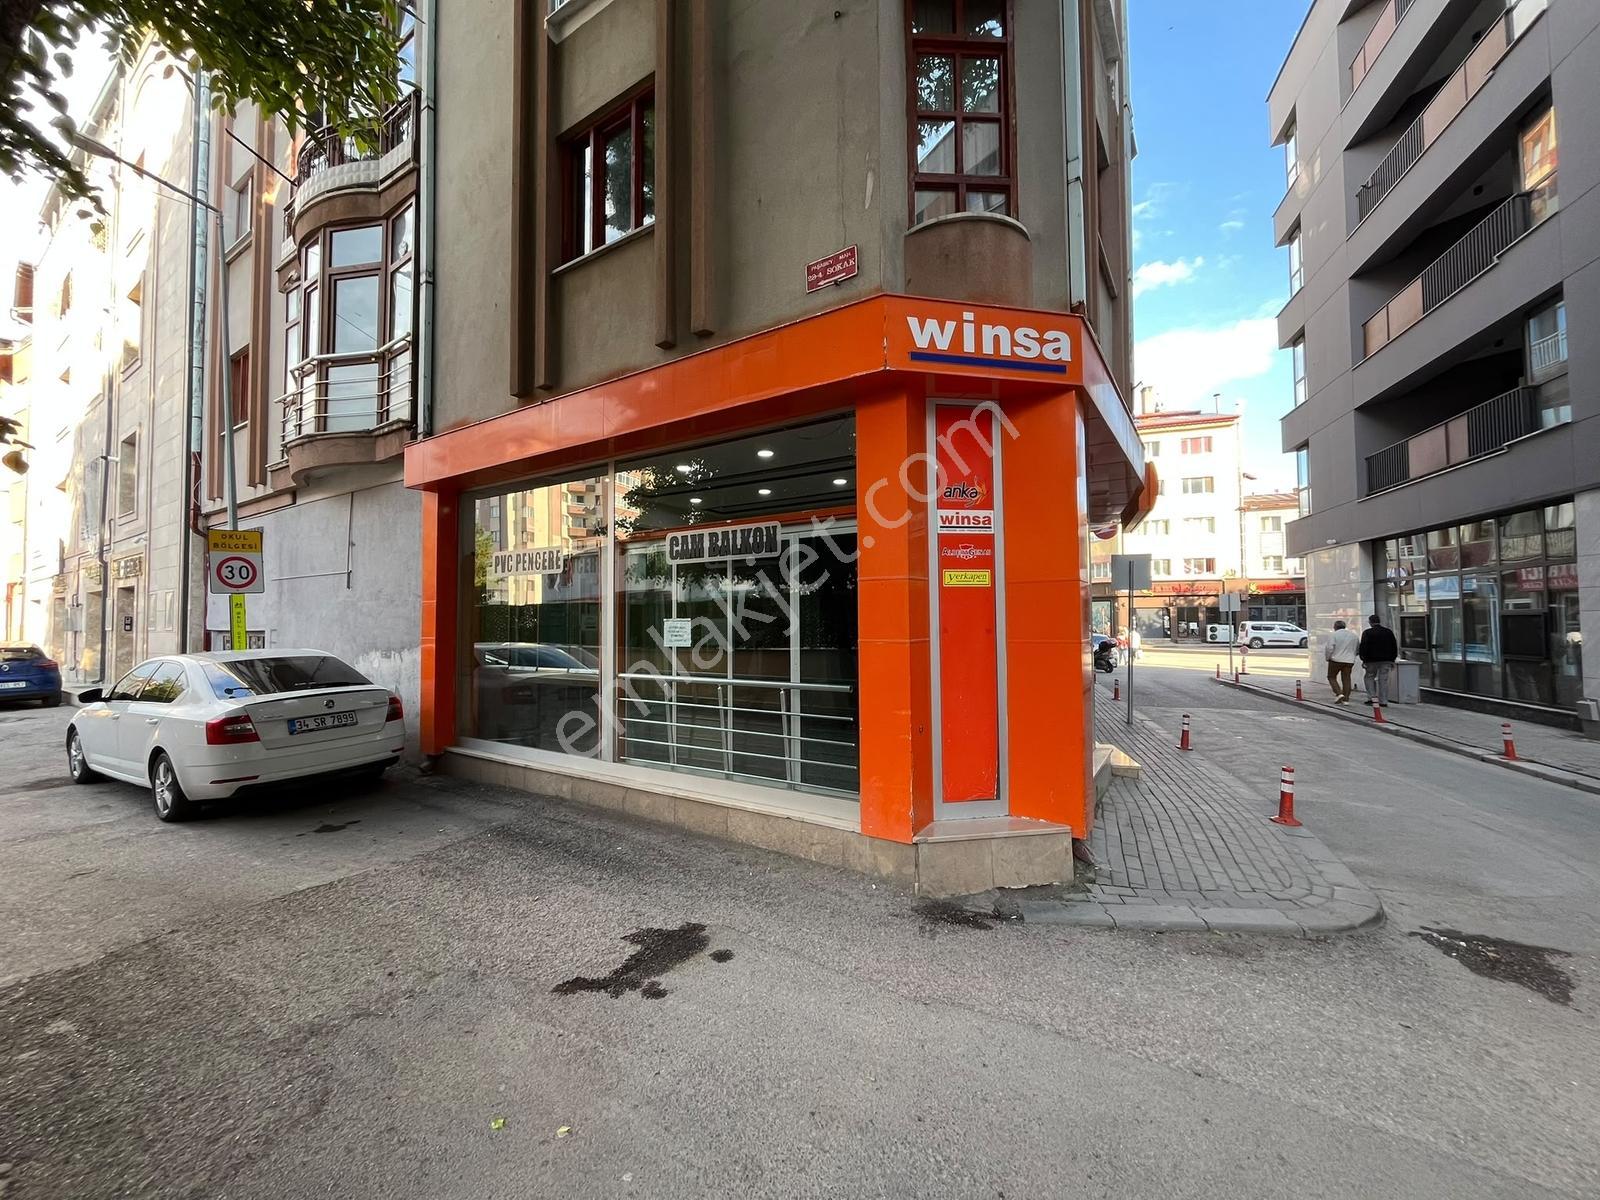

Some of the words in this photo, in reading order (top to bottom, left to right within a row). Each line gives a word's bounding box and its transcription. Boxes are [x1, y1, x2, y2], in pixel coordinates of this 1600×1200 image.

[827, 258, 855, 275] SOKAK
[906, 311, 1072, 361] winsa
[943, 482, 978, 499] anka
[939, 512, 992, 526] winsa
[221, 533, 248, 541] OKUL
[669, 533, 705, 560] CAM
[708, 525, 778, 558] BALKON
[494, 554, 513, 574] PVC
[515, 550, 561, 572] PENCERE
[224, 565, 250, 580] 30
[296, 720, 309, 730] 34
[315, 717, 327, 727] SR
[332, 713, 355, 724] 7899
